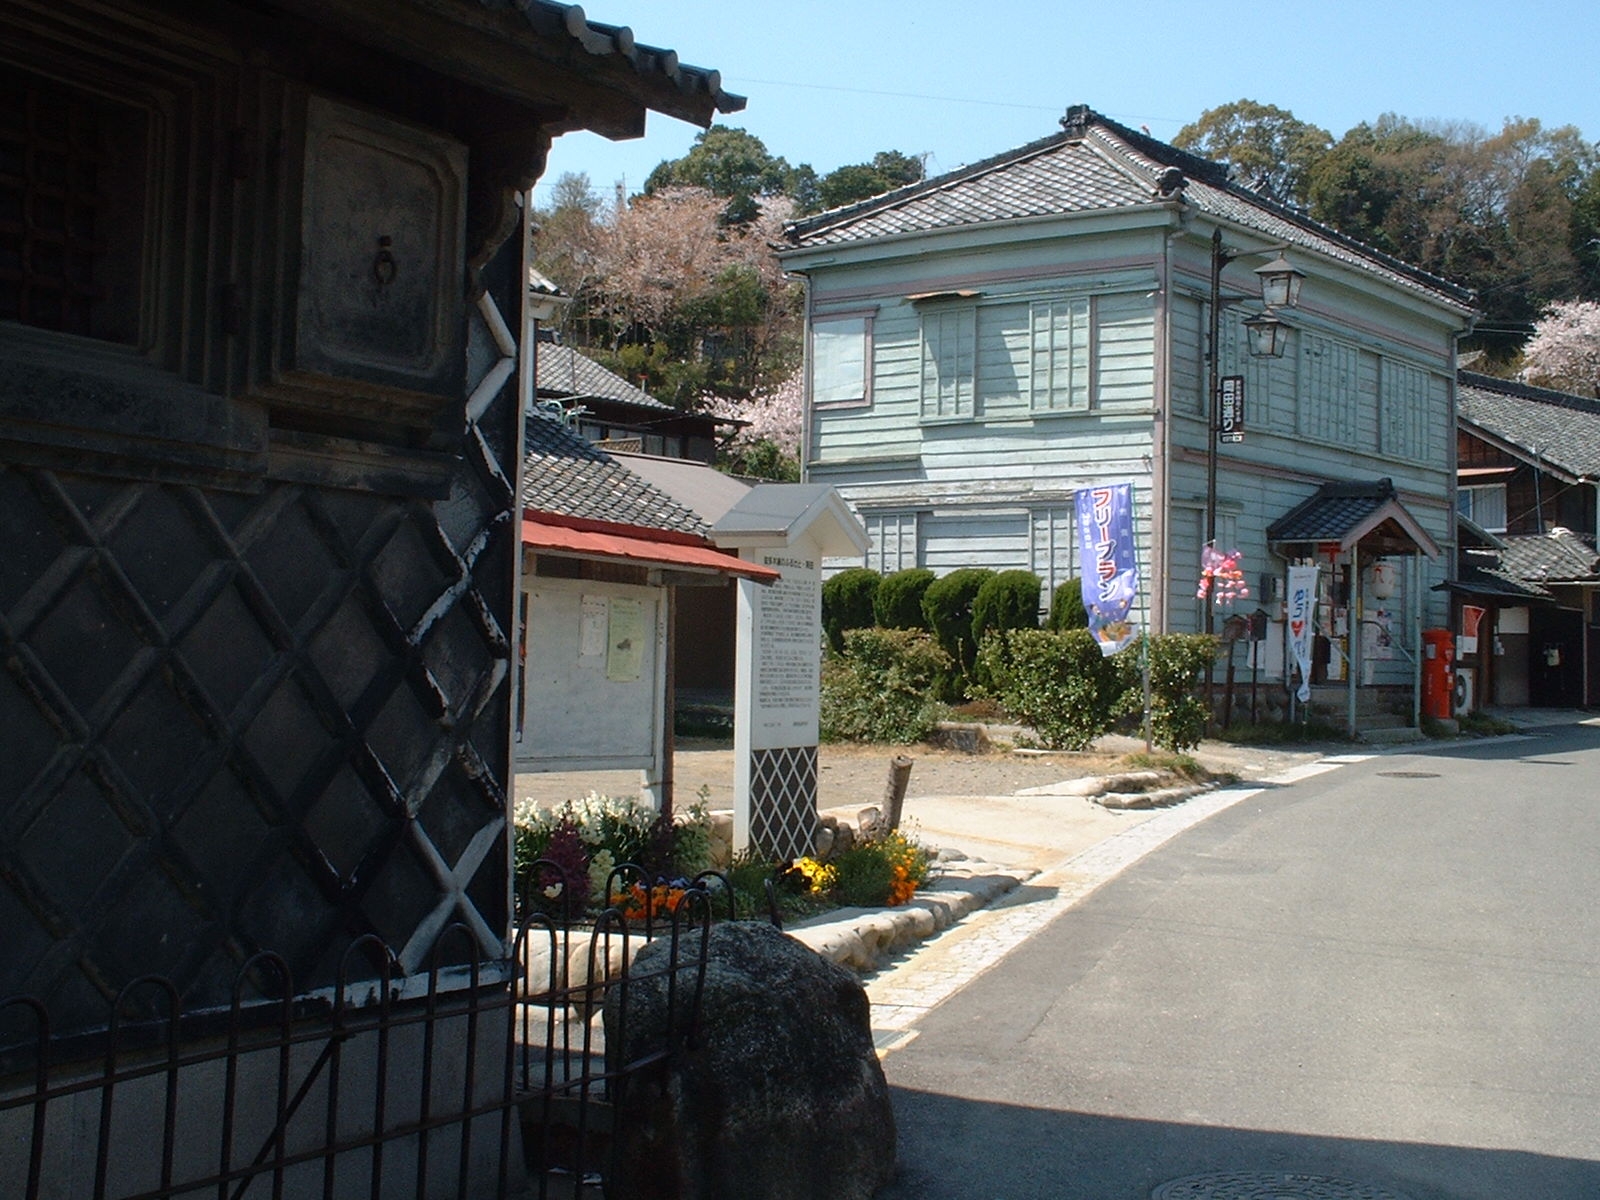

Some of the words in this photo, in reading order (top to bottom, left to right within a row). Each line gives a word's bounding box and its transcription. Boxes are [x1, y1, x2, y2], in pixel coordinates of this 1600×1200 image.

[1091, 489, 1118, 602] フリープラン
